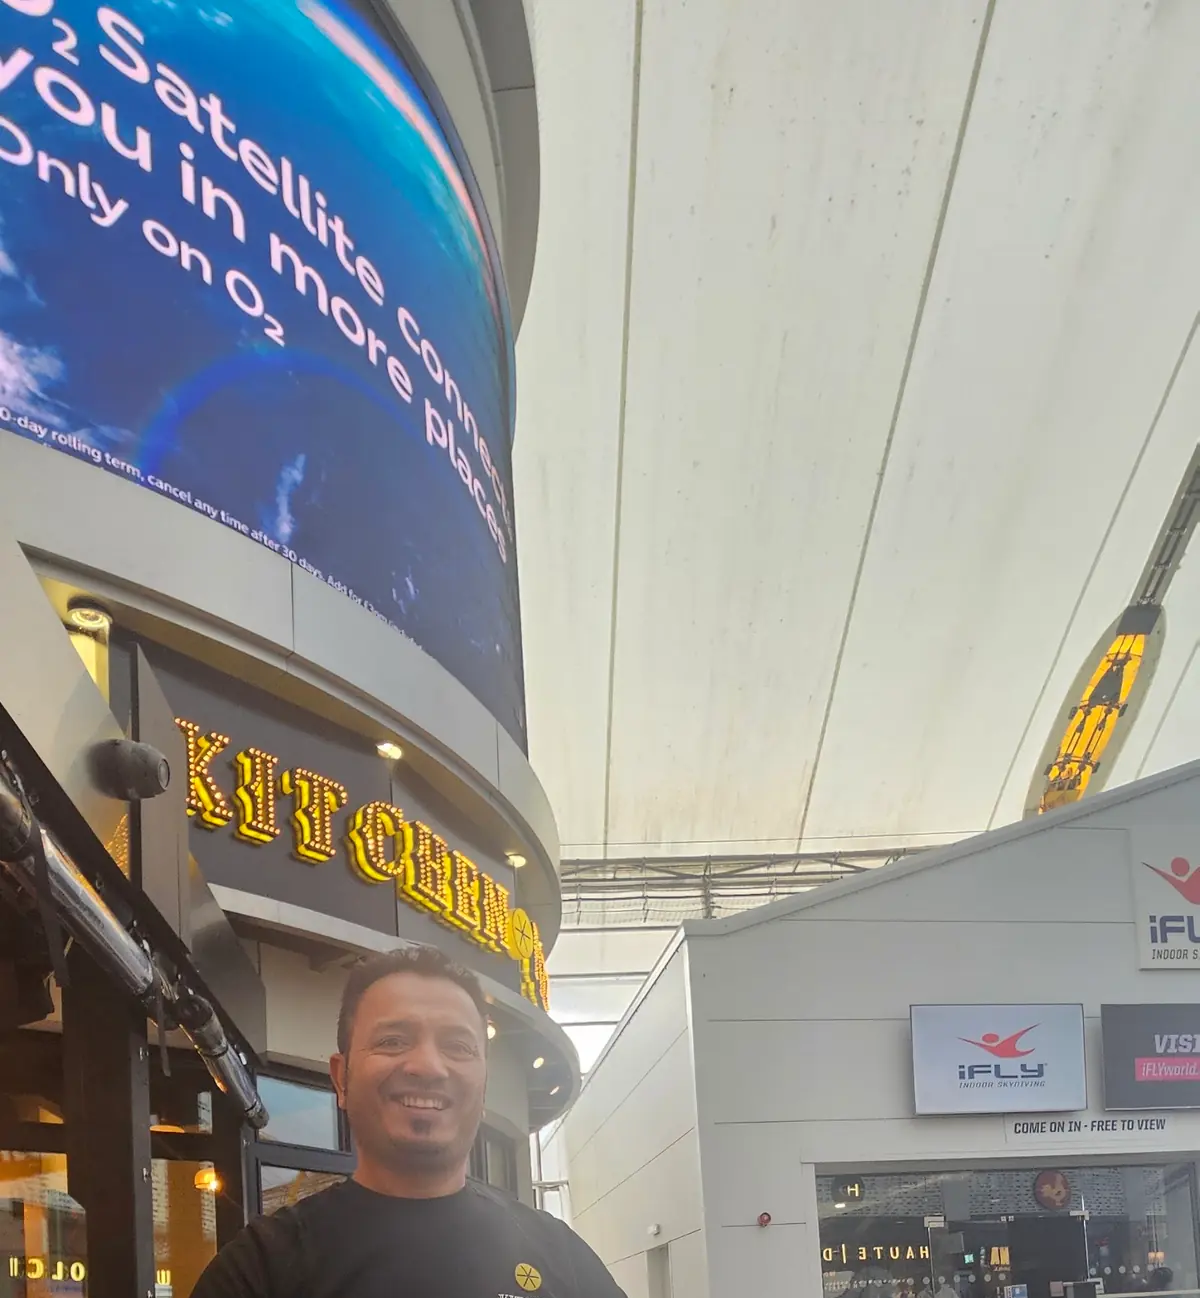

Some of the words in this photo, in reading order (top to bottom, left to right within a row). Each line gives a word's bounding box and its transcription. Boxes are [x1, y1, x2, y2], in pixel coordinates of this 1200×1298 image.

[0, 115, 129, 228] Only
[142, 219, 212, 285] on
[97, 6, 385, 306] Satellite
[180, 142, 245, 243] in
[269, 232, 413, 402] more
[424, 397, 507, 564] places
[51, 430, 102, 463] rolling
[104, 451, 145, 482] term,
[147, 474, 193, 504] cancel
[193, 498, 223, 519] any
[219, 510, 249, 534] time
[250, 527, 281, 552] after
[281, 544, 298, 562] 30
[326, 574, 348, 594] Add
[174, 715, 511, 953] KITCHEN
[1151, 948, 1189, 960] INDOOR
[958, 1063, 1045, 1080] iFLY
[997, 1080, 1046, 1088] SKYDIVING
[1014, 1122, 1046, 1134] COME
[1049, 1121, 1065, 1133] ON
[1068, 1120, 1082, 1132] IN
[1090, 1120, 1118, 1132] FREE
[1121, 1119, 1134, 1131] TO
[1137, 1118, 1166, 1130] VIEW
